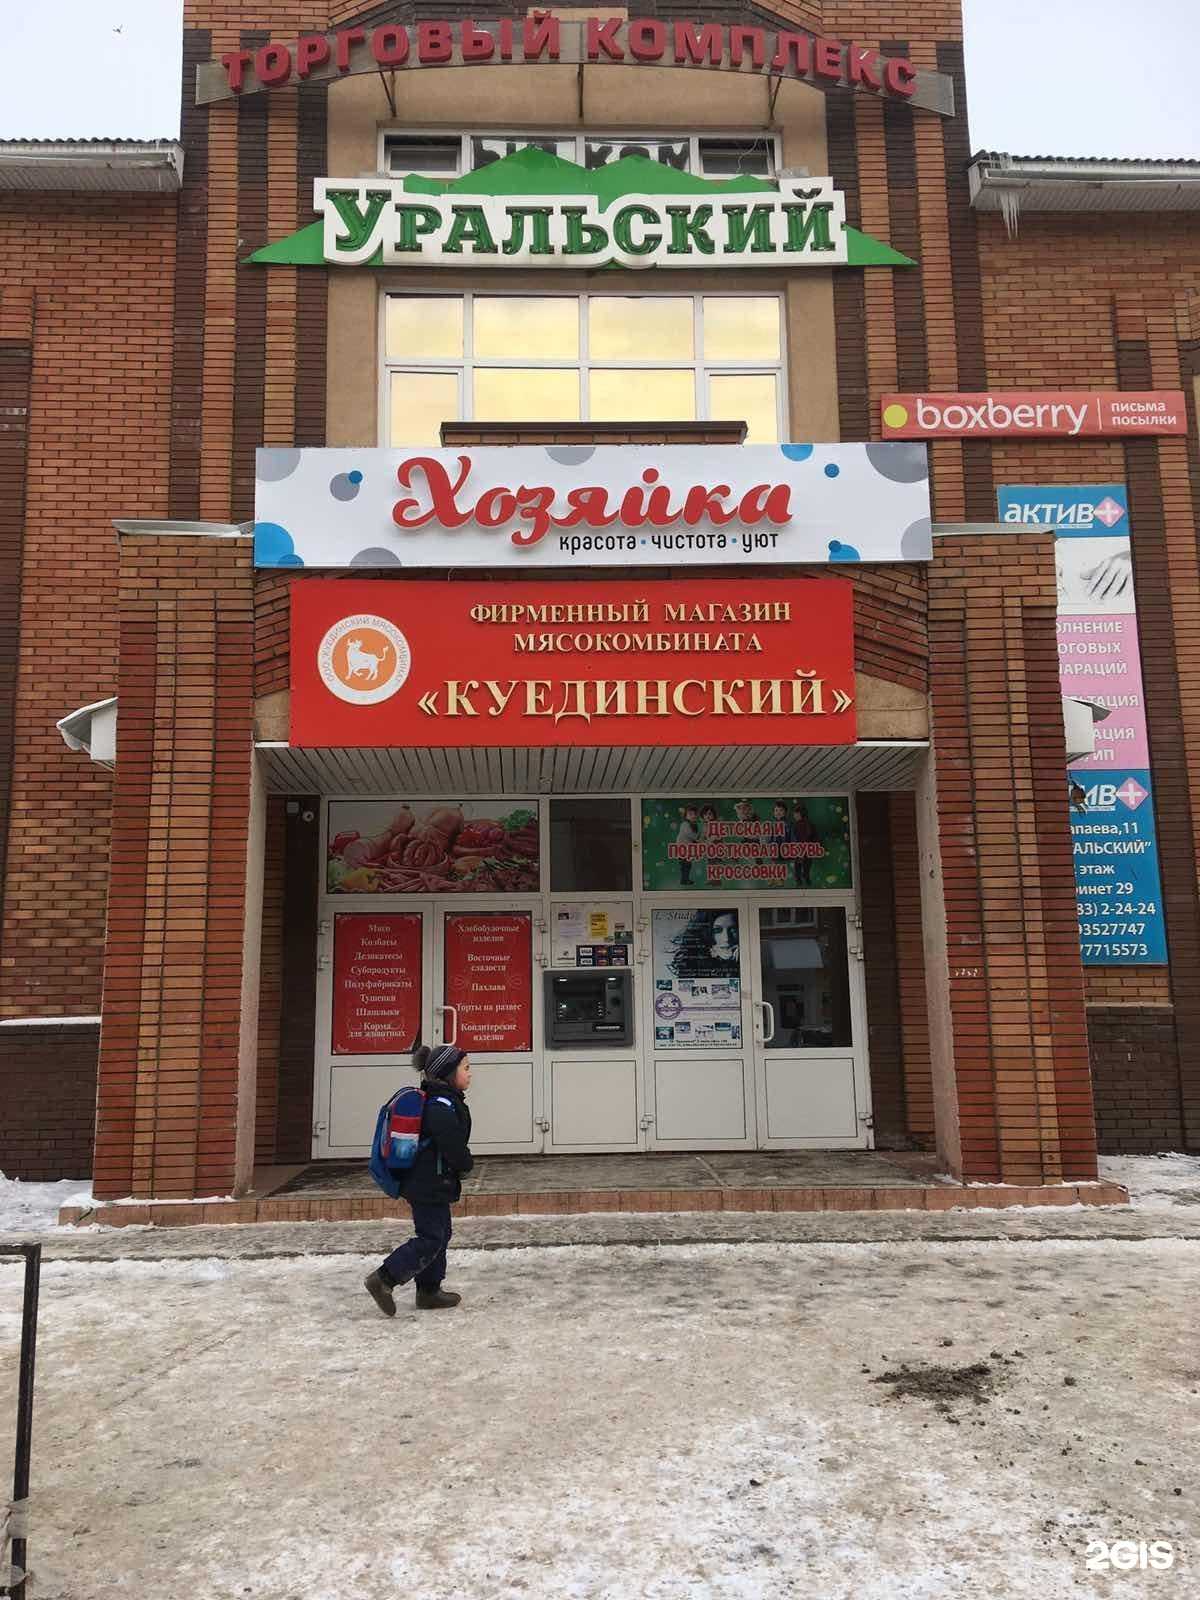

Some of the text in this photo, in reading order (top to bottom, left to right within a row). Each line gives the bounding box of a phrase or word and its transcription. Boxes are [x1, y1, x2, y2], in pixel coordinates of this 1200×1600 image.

[221, 10, 919, 98] ТОРГОВЫЙ КОМПЛЕКС
[325, 186, 837, 255] УРАЛЬСКИЙ
[1111, 402, 1166, 413] письма
[916, 397, 1088, 435] boxberry
[1112, 415, 1177, 426] посылки
[391, 455, 793, 547] Хозяйка
[559, 533, 779, 554] красота чистота уют
[470, 600, 792, 623] ФИРМЕННЫЙ МАГАЗИН
[514, 632, 763, 652] МЯСОКОМБИНАТА
[418, 669, 853, 726] «КУЕДИНСКИЙ»
[709, 822, 785, 838] ДЕТСКАЯ И
[668, 841, 825, 861] ПОДРОСТКОВАЯ ОБУВЬ
[707, 864, 788, 880] КРОССОВКИ
[1080, 865, 1115, 875] этаж
[1076, 882, 1133, 895] инет 29
[1101, 902, 1156, 915] 2-24-24
[354, 951, 403, 961] Деликатесы
[351, 966, 406, 976] Субпродукты
[344, 979, 412, 990] Полуфабрикаты
